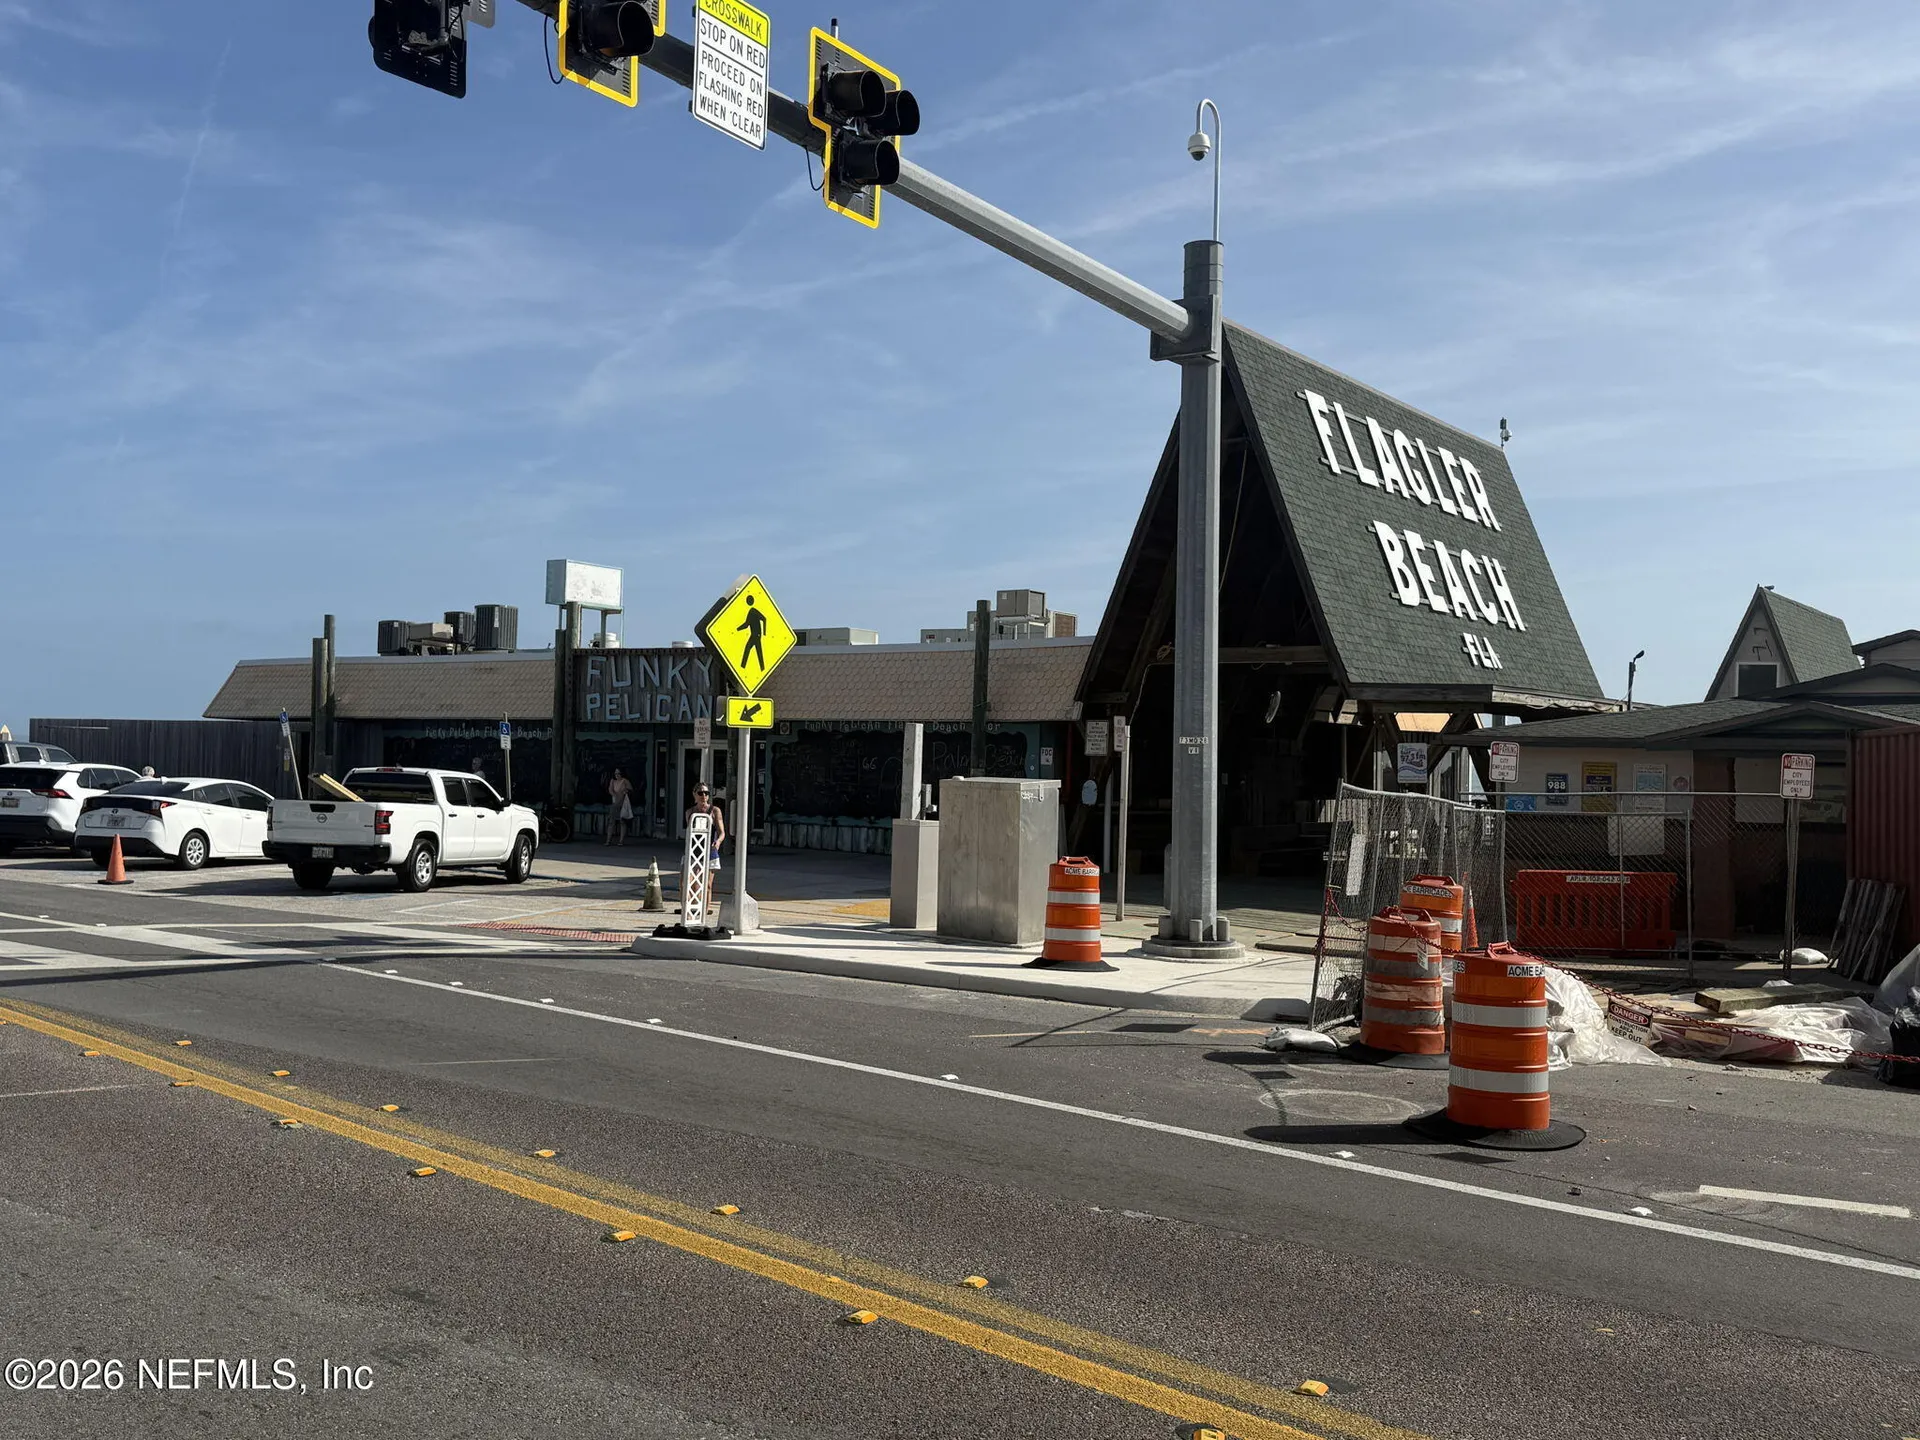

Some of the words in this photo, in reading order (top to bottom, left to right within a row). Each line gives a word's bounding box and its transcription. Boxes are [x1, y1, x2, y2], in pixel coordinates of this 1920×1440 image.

[701, 18, 726, 45] STOP
[729, 35, 744, 57] ON
[746, 44, 765, 69] RED
[702, 50, 745, 87] PROCEED
[749, 78, 763, 97] ON
[699, 71, 743, 107] FLASHING
[746, 97, 763, 119] RED
[699, 93, 727, 121] WHEN
[731, 111, 761, 139] CLEAR
[1303, 388, 1502, 531] FLAGLER
[1372, 519, 1526, 631] BEACH
[1462, 632, 1503, 669] FLA
[586, 654, 714, 690] FUNKY
[585, 692, 713, 722] PELICAN
[1492, 743, 1499, 754] NO
[1499, 743, 1517, 754] PARKING
[1784, 755, 1792, 768] NO
[1792, 756, 1812, 768] PARKING
[1547, 781, 1566, 790] 988
[1065, 867, 1081, 875] ACME
[1508, 965, 1534, 977] ACME
[1609, 1014, 1649, 1034] CONSTRUCTION
[1613, 1006, 1644, 1022] DANGER
[1611, 1026, 1628, 1038] KEEP
[1628, 1033, 1642, 1043] OUT
[1619, 1025, 1634, 1034] AREA
